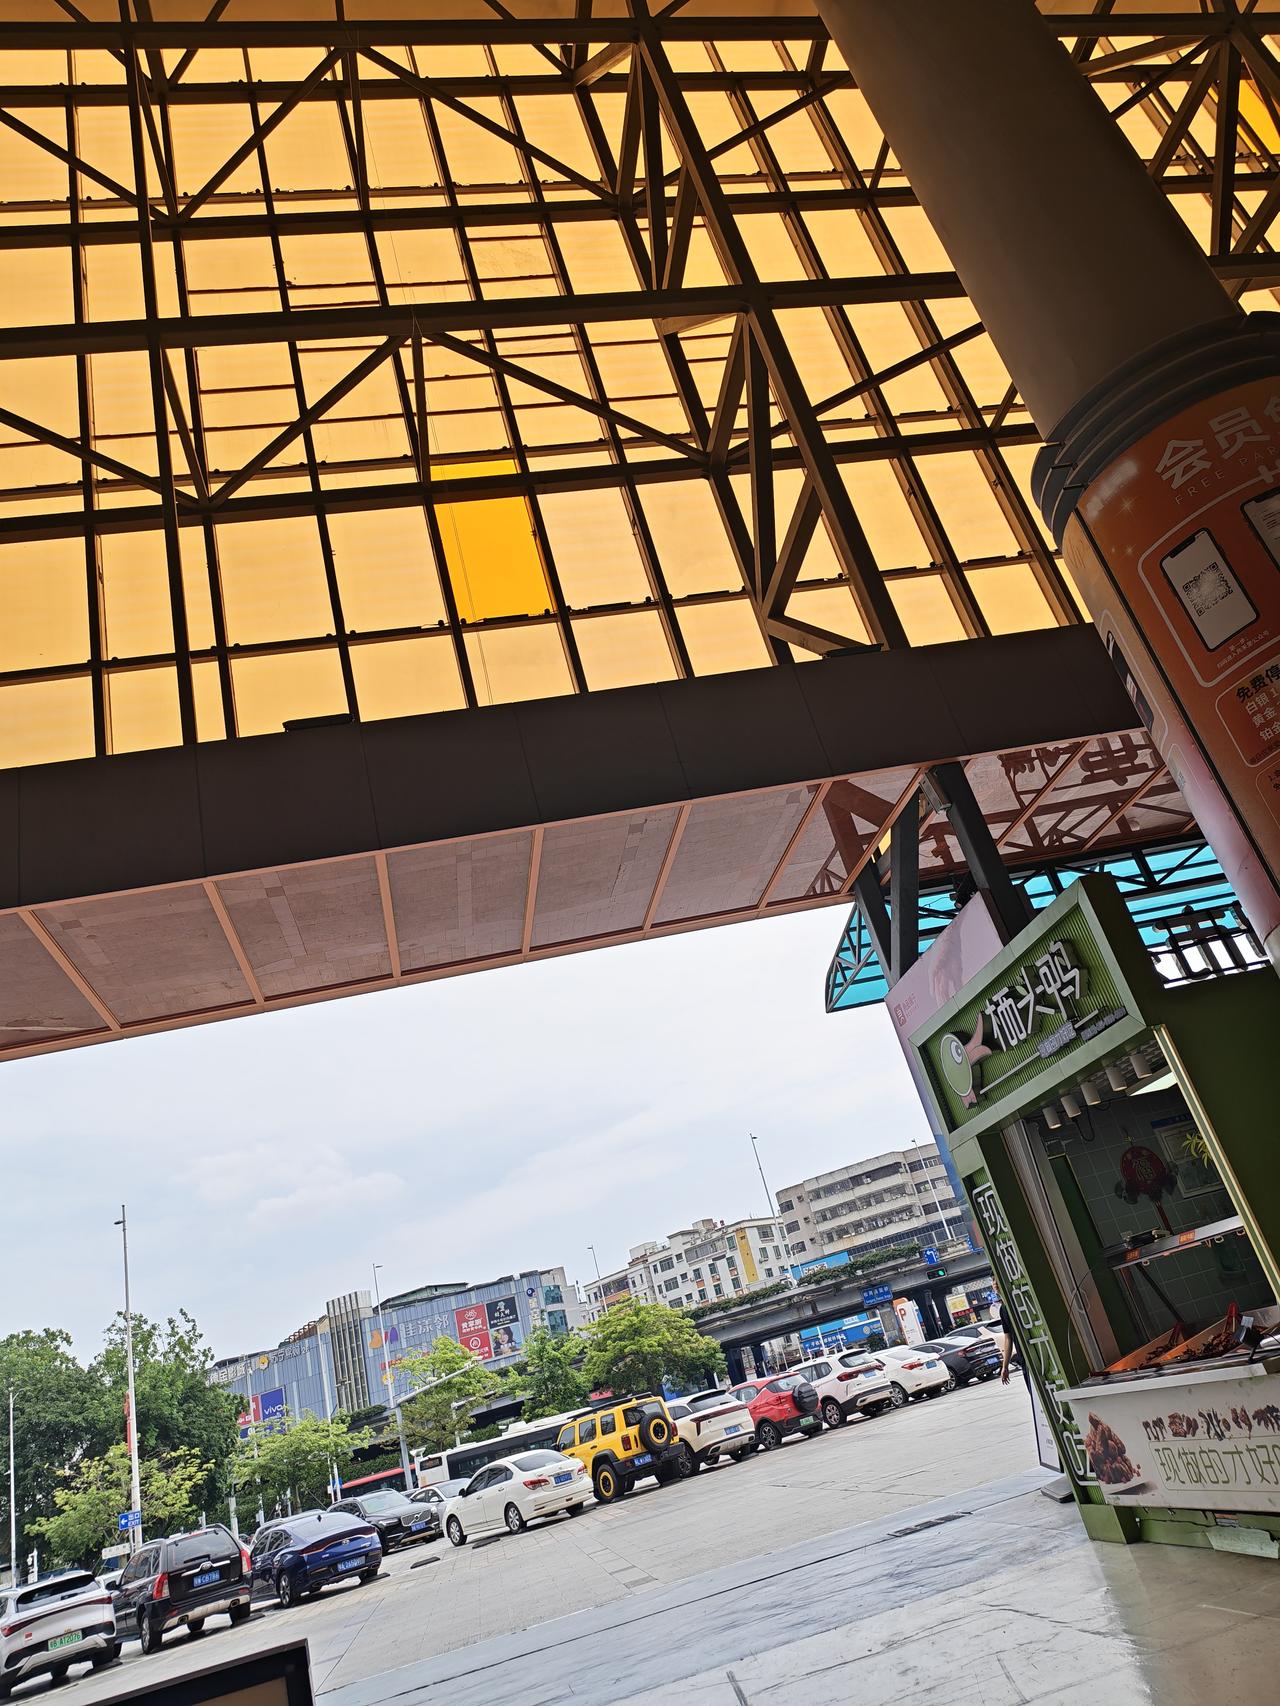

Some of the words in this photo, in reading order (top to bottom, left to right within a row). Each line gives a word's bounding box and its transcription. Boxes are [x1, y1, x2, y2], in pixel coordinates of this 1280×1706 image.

[1175, 469, 1226, 505] FREE
[1245, 692, 1270, 715] 白银
[1252, 706, 1277, 729] 黄金
[264, 1404, 284, 1415] vivo
[1154, 1443, 1280, 1485] 现做的才好
[128, 1519, 140, 1527] EXIT
